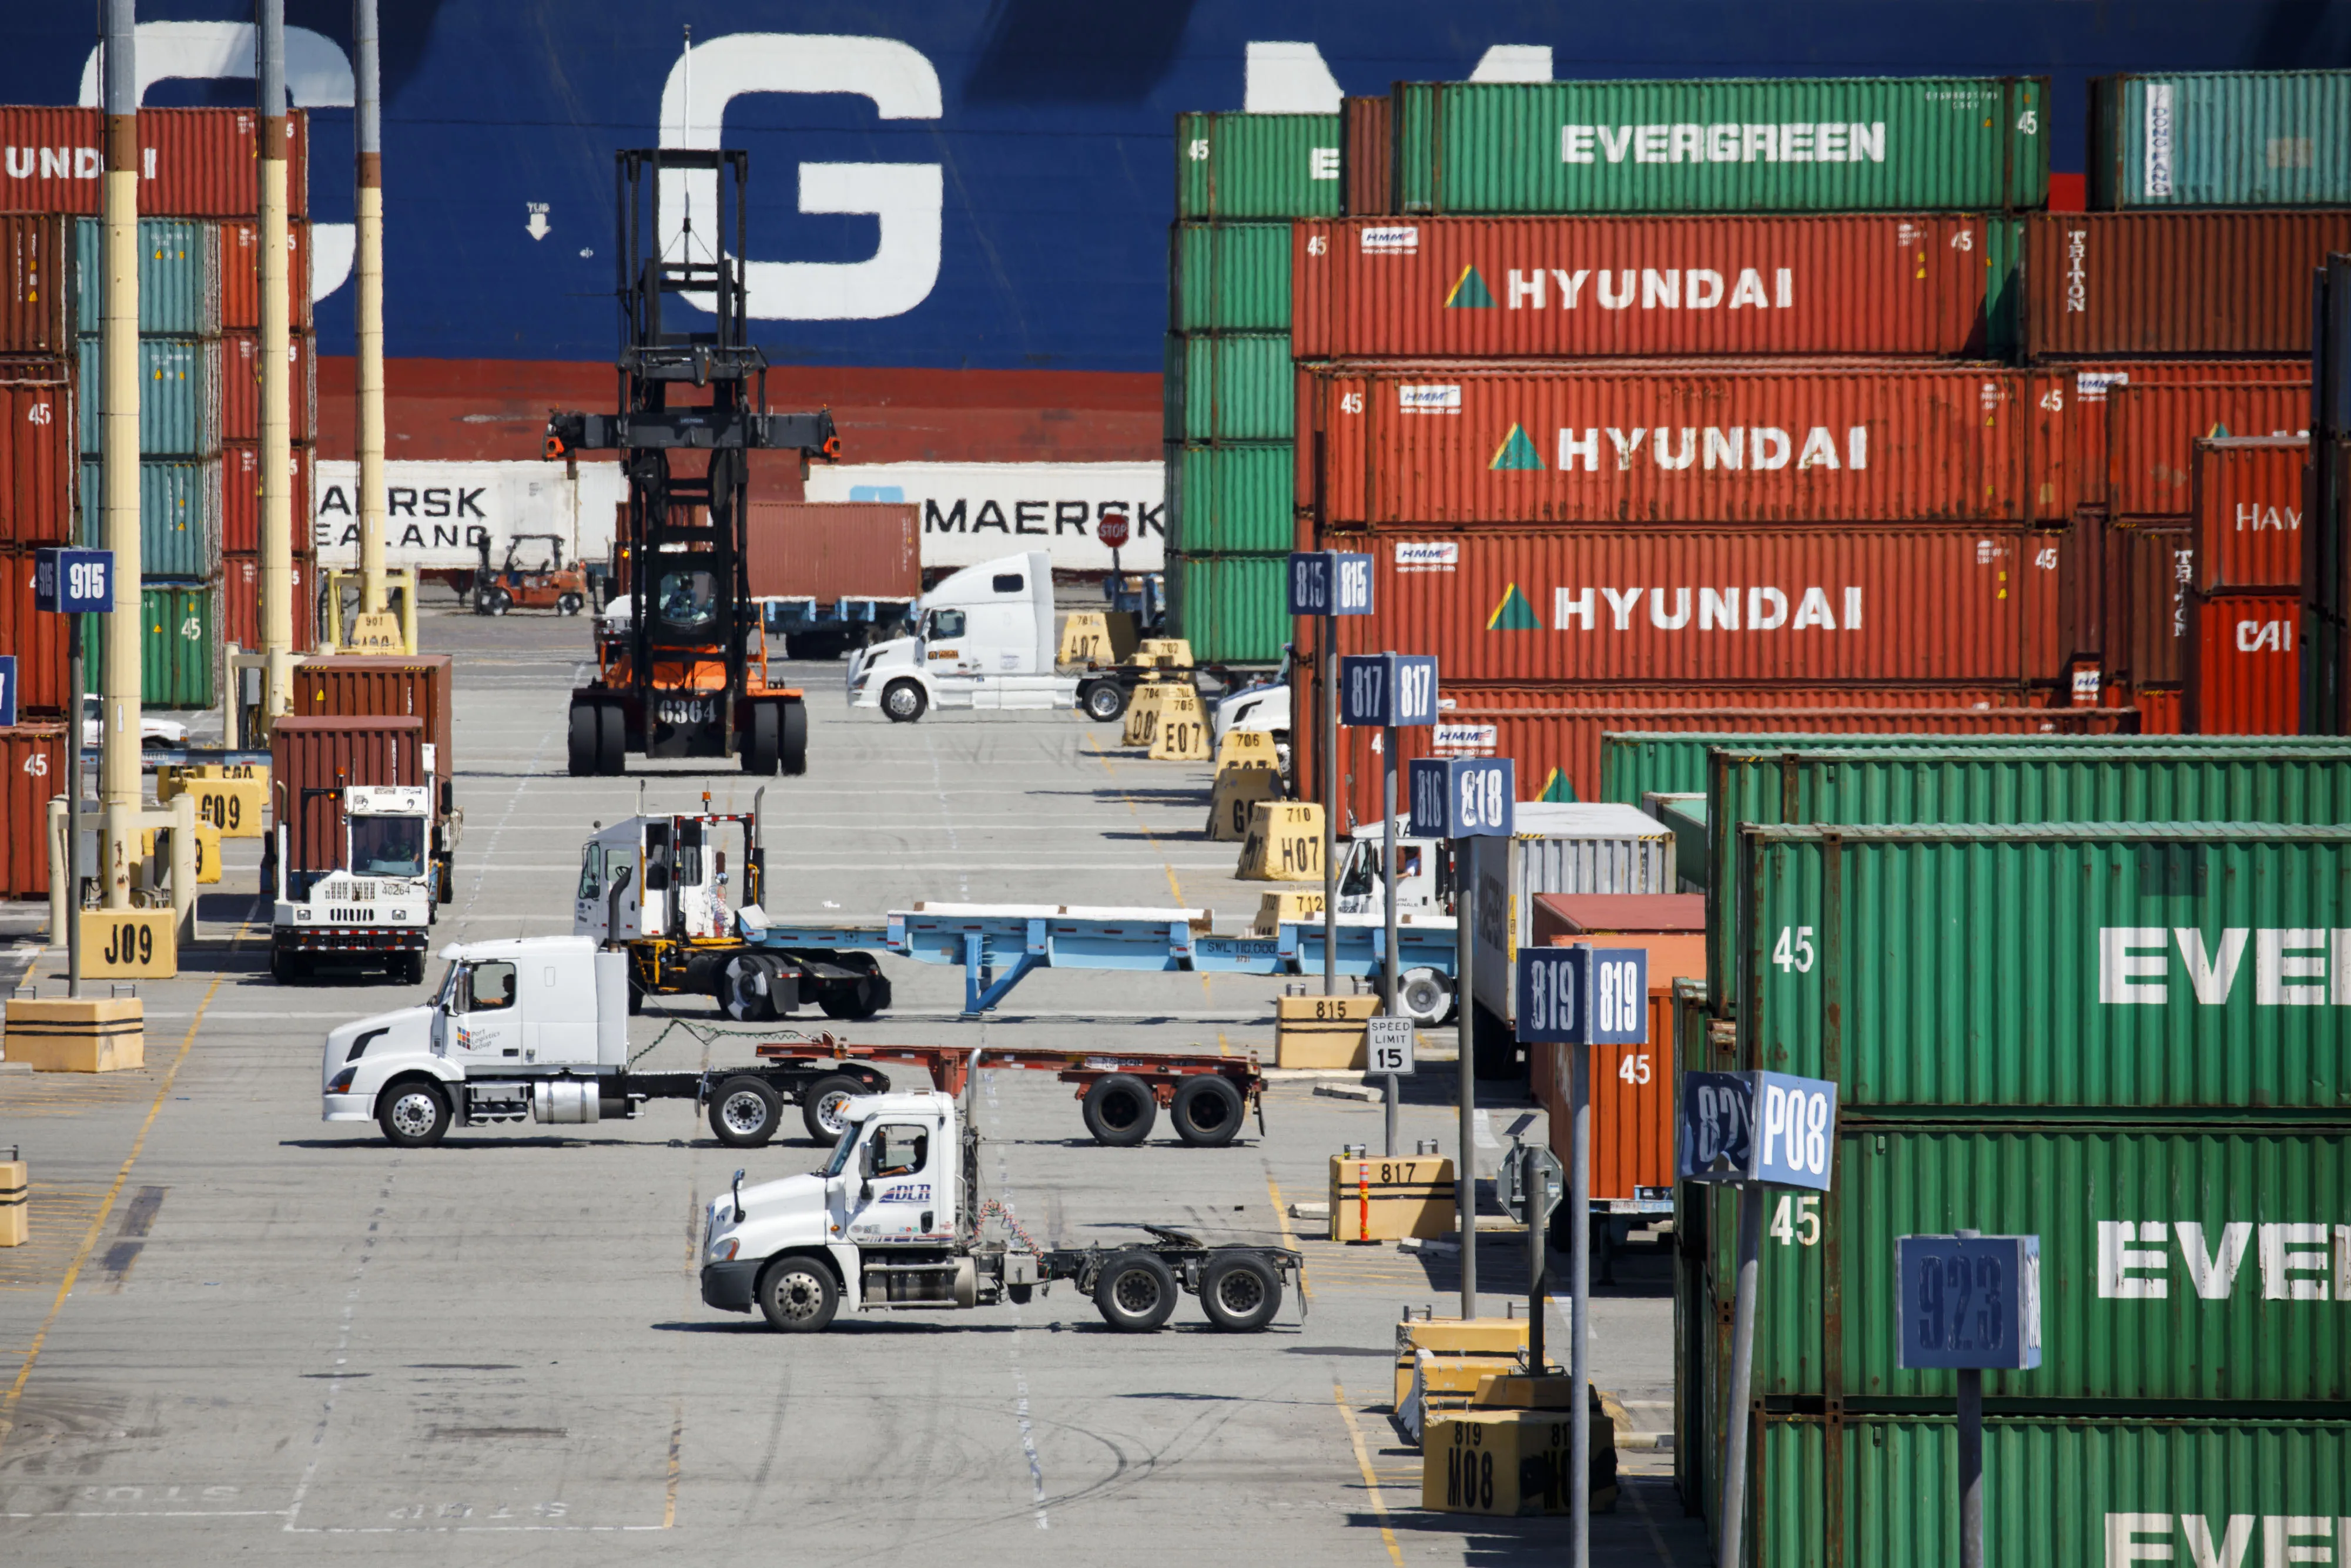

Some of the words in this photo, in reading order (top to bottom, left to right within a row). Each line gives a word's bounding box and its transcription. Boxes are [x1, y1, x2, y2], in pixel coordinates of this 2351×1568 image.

[2017, 110, 2038, 135] 45
[1188, 139, 1209, 162] 45
[1562, 122, 1886, 164] EVERGREEN
[5, 146, 157, 180] UNDI
[1310, 148, 1340, 180] E
[1307, 235, 1327, 256] 45
[1367, 233, 1404, 242] HMM
[1951, 230, 1973, 252] 45
[2066, 230, 2087, 312] TRITON
[1508, 268, 1792, 310] HYUNDAI
[1341, 392, 1363, 415] 45
[2040, 388, 2064, 411] 45
[29, 403, 51, 425] 45
[1558, 425, 1868, 472] HYUNDAI
[319, 485, 487, 518] ARSK
[316, 523, 488, 548] EAAND
[1099, 522, 1127, 538] STOP
[1402, 549, 1442, 558] HMM
[2035, 548, 2057, 570] 45
[39, 562, 53, 597] 915
[69, 562, 105, 599] 915
[1296, 561, 1325, 608] 815
[1340, 559, 1367, 608] 815
[1554, 585, 1863, 631] HYUNDAI
[181, 617, 202, 641] 45
[2237, 620, 2292, 652] CAI
[1071, 635, 1100, 659] A07
[1352, 665, 1382, 718] 817
[1401, 664, 1432, 718] 817
[658, 699, 717, 724] 6364
[1166, 722, 1201, 753] E07
[1237, 733, 1260, 748] 706
[1371, 733, 1384, 755] 4
[1439, 732, 1480, 741] HMM
[24, 752, 48, 776] 45
[201, 793, 240, 830] G09
[1287, 807, 1311, 822] 710
[1281, 836, 1319, 873] H07
[382, 885, 410, 896] 40264
[1297, 896, 1324, 912] 712
[104, 923, 153, 966] J09
[1208, 942, 1231, 953] SWL
[1235, 942, 1276, 954] 110,000
[1773, 926, 1815, 973] 45
[1531, 960, 1575, 1031] 819
[1599, 961, 1637, 1032] 819
[1317, 1000, 1347, 1020] 815
[471, 1028, 485, 1038] Port
[471, 1031, 500, 1045] Logistics
[1371, 1021, 1410, 1032] SPEED
[1375, 1034, 1406, 1044] LIMIT
[471, 1041, 492, 1051] Group
[1377, 1048, 1403, 1068] 15
[1619, 1054, 1650, 1084] 45
[1763, 1084, 1828, 1175] P08
[1381, 1162, 1416, 1183] 817
[1770, 1195, 1821, 1246] 45
[2097, 1220, 2351, 1301] EVE
[1918, 1254, 2004, 1351] 923
[1454, 1421, 1482, 1447] 819
[1550, 1422, 1571, 1445] 81
[1446, 1446, 1494, 1510] M08
[1543, 1448, 1572, 1510] M0
[2104, 1512, 2351, 1568] EVE
